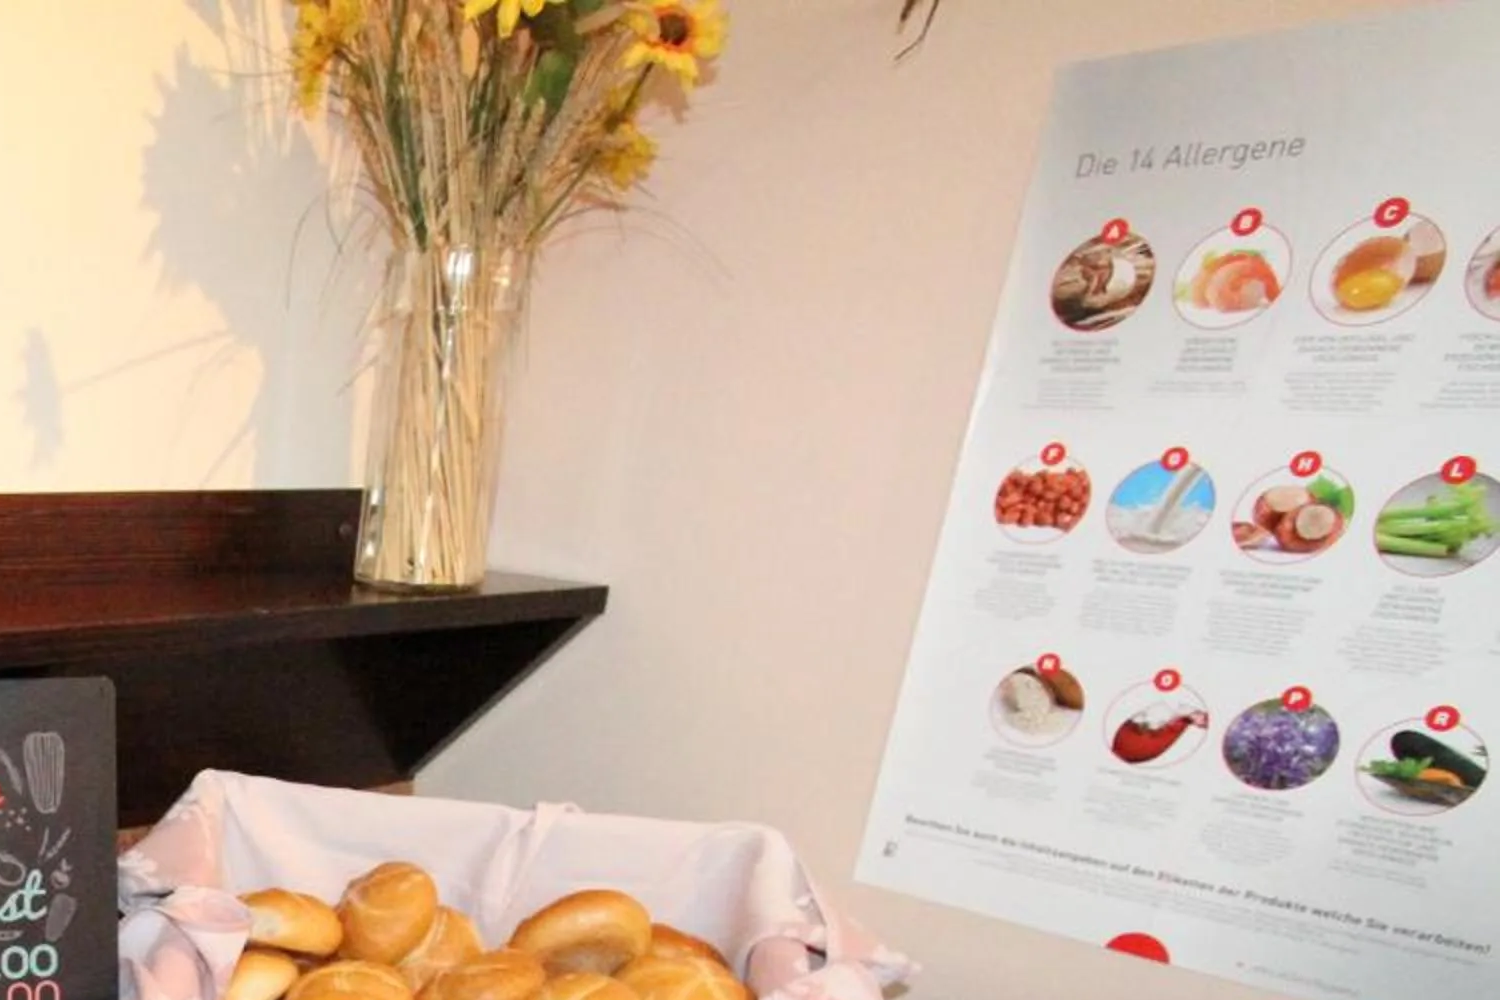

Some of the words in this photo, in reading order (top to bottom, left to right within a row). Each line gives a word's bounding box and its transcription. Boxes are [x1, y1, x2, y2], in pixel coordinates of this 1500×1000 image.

[1075, 151, 1119, 179] Die
[1129, 147, 1155, 172] 14
[1162, 136, 1307, 171] Allergene
[1217, 885, 1241, 897] der
[1243, 889, 1308, 913] Produkte
[1310, 908, 1362, 926] welche
[1365, 917, 1389, 931] Sie
